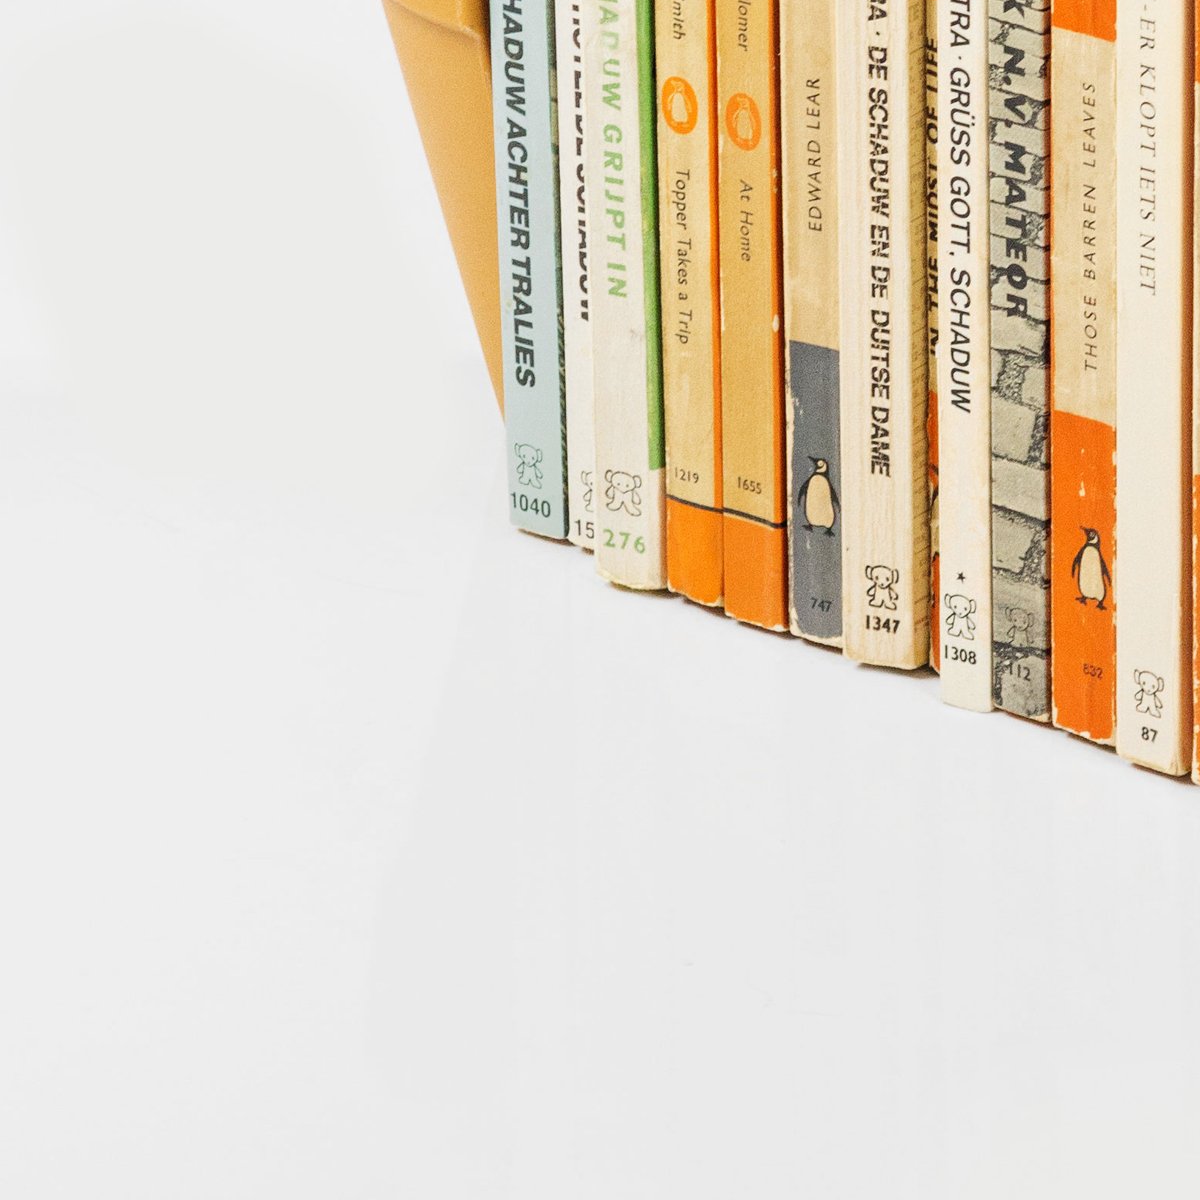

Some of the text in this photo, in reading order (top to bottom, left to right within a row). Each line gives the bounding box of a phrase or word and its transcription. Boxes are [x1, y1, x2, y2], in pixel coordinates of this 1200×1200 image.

[868, 46, 889, 81] DE
[950, 66, 976, 168] GRÜSS
[1139, 64, 1157, 159] KLOPT
[806, 76, 823, 232] EDWARD LEAR
[868, 87, 890, 216] SCHADUW
[506, 118, 530, 251] ACHTER
[602, 123, 628, 253] GRIJPT
[949, 175, 971, 257] GOTT,
[1140, 166, 1156, 223] IETS
[739, 178, 754, 263] At Home
[870, 224, 890, 259] EN
[1004, 141, 1029, 318] MATEOR
[1082, 82, 1098, 373] THOSE BARREN LEAVES
[606, 262, 629, 298] IN
[673, 168, 694, 345] Topper Takes a Trip
[871, 265, 891, 299] DE
[1139, 233, 1157, 297] NIET
[511, 256, 537, 388] TRALIES
[950, 267, 972, 414] SCHADUW
[870, 309, 891, 401] DUITSE
[870, 405, 892, 479] DAME
[510, 492, 551, 518] 1040
[674, 468, 700, 484] 1219
[737, 476, 763, 495] 1655
[575, 519, 595, 540] 15
[603, 529, 647, 554] 276
[811, 598, 833, 612] 747
[865, 615, 901, 634] 1347
[943, 645, 977, 664] 1308
[1083, 663, 1103, 679] 832
[1141, 727, 1158, 743] 87
